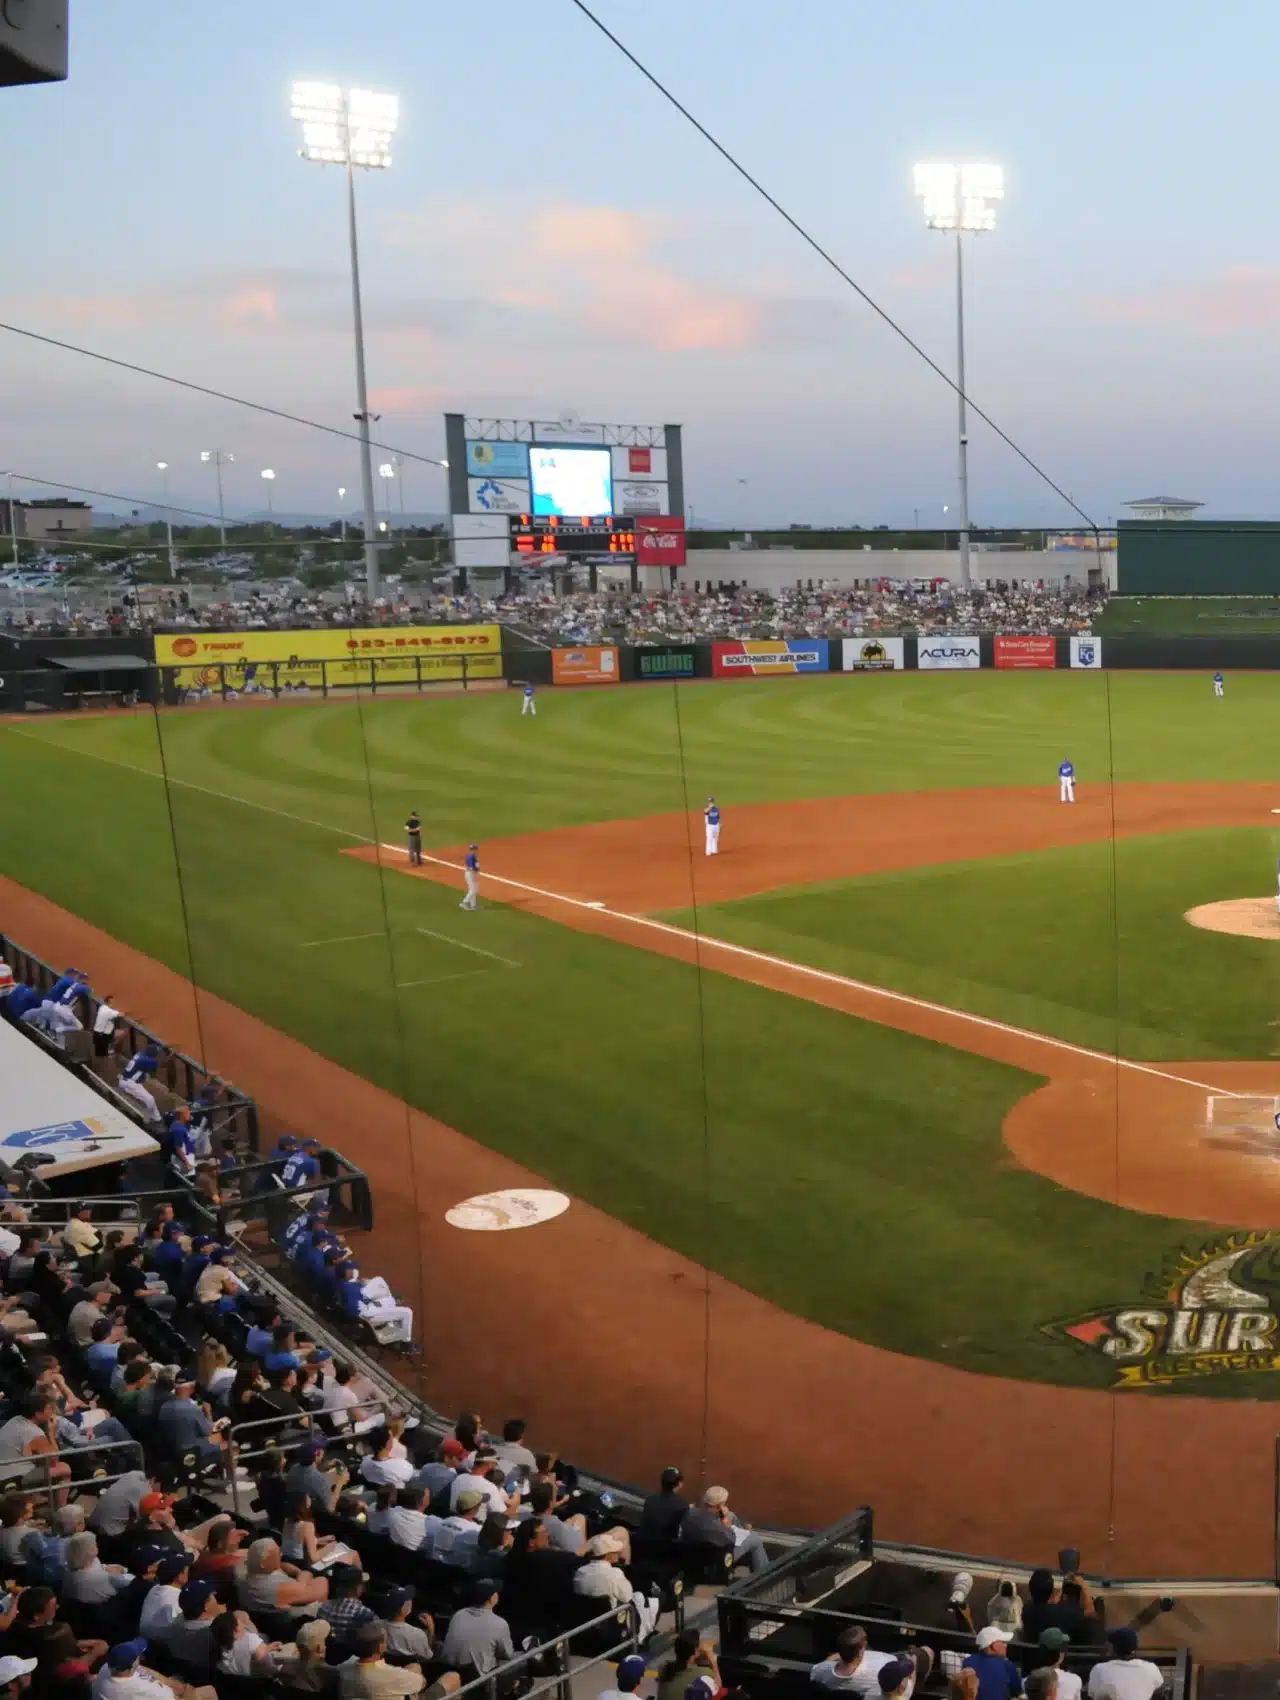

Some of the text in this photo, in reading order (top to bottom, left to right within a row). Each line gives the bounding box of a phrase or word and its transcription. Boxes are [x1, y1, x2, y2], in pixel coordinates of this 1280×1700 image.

[919, 648, 979, 658] ACURA
[725, 653, 816, 665] SOUTHWEST AIRLINES
